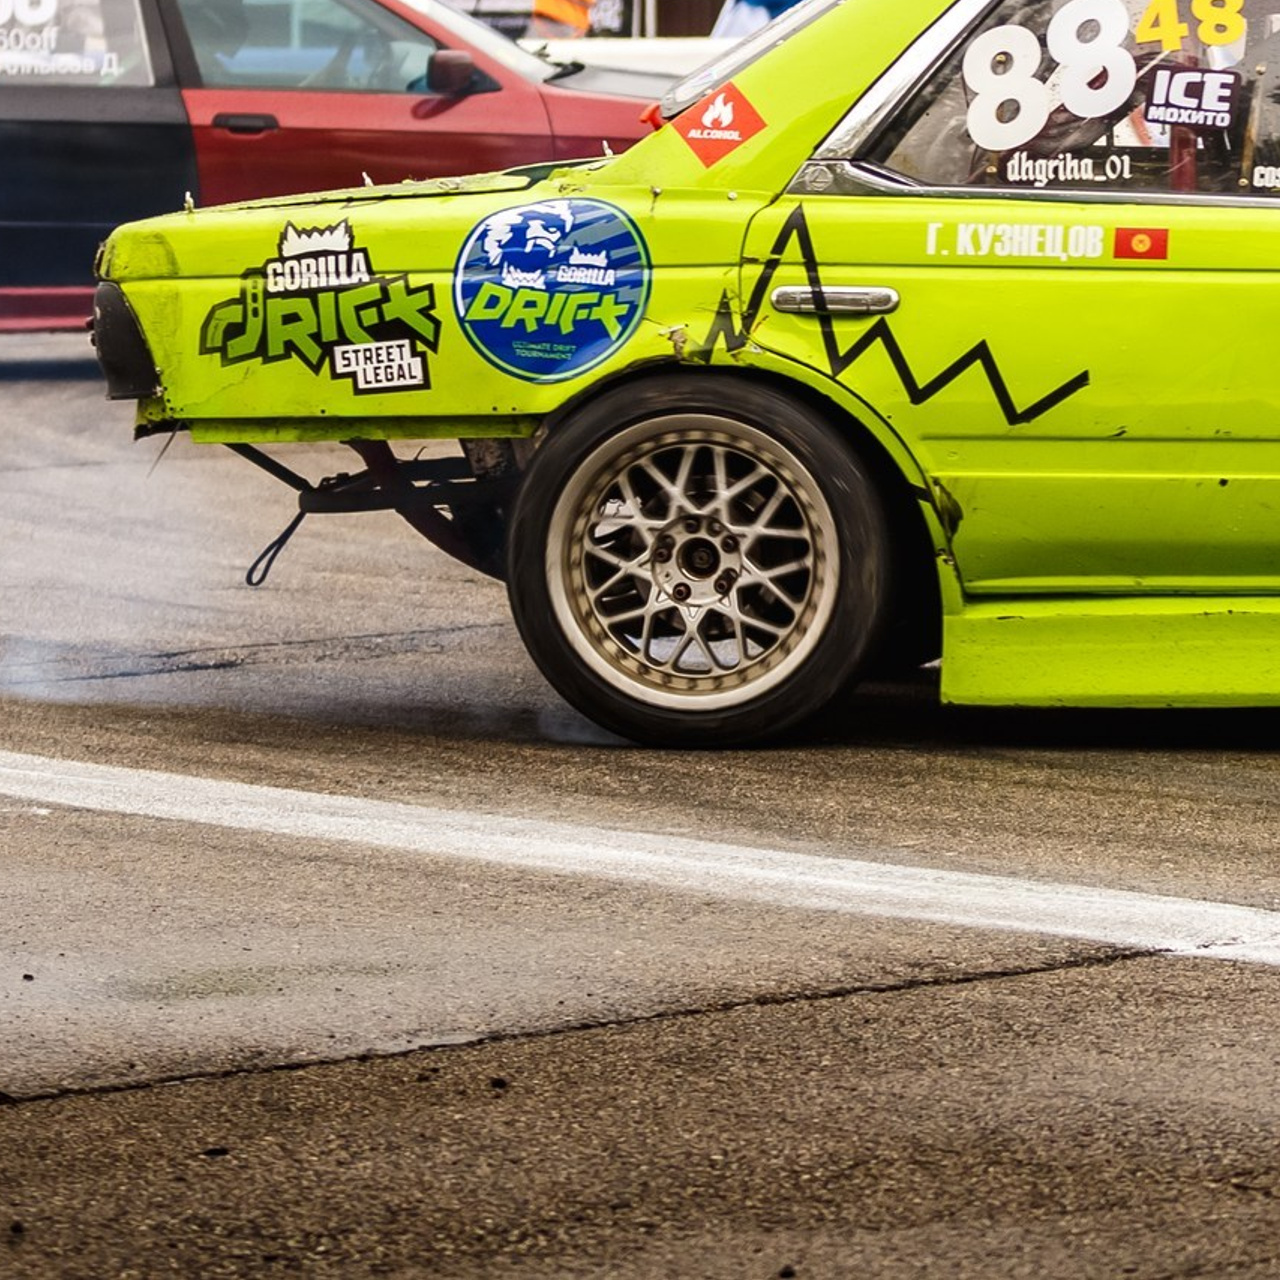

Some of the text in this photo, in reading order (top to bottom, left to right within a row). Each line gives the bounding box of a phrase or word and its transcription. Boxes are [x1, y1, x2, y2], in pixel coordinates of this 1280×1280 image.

[1152, 70, 1235, 111] ICE
[1147, 106, 1231, 127] МОХИТО
[687, 129, 742, 141] ALCOHOL
[926, 223, 1104, 261] Г. КУЗНЕЦОВ
[266, 252, 370, 293] GORILLA
[557, 265, 615, 286] GORILLA
[465, 282, 630, 341] DRIFT
[341, 343, 406, 368] STREET
[363, 362, 417, 385] LEGAL
